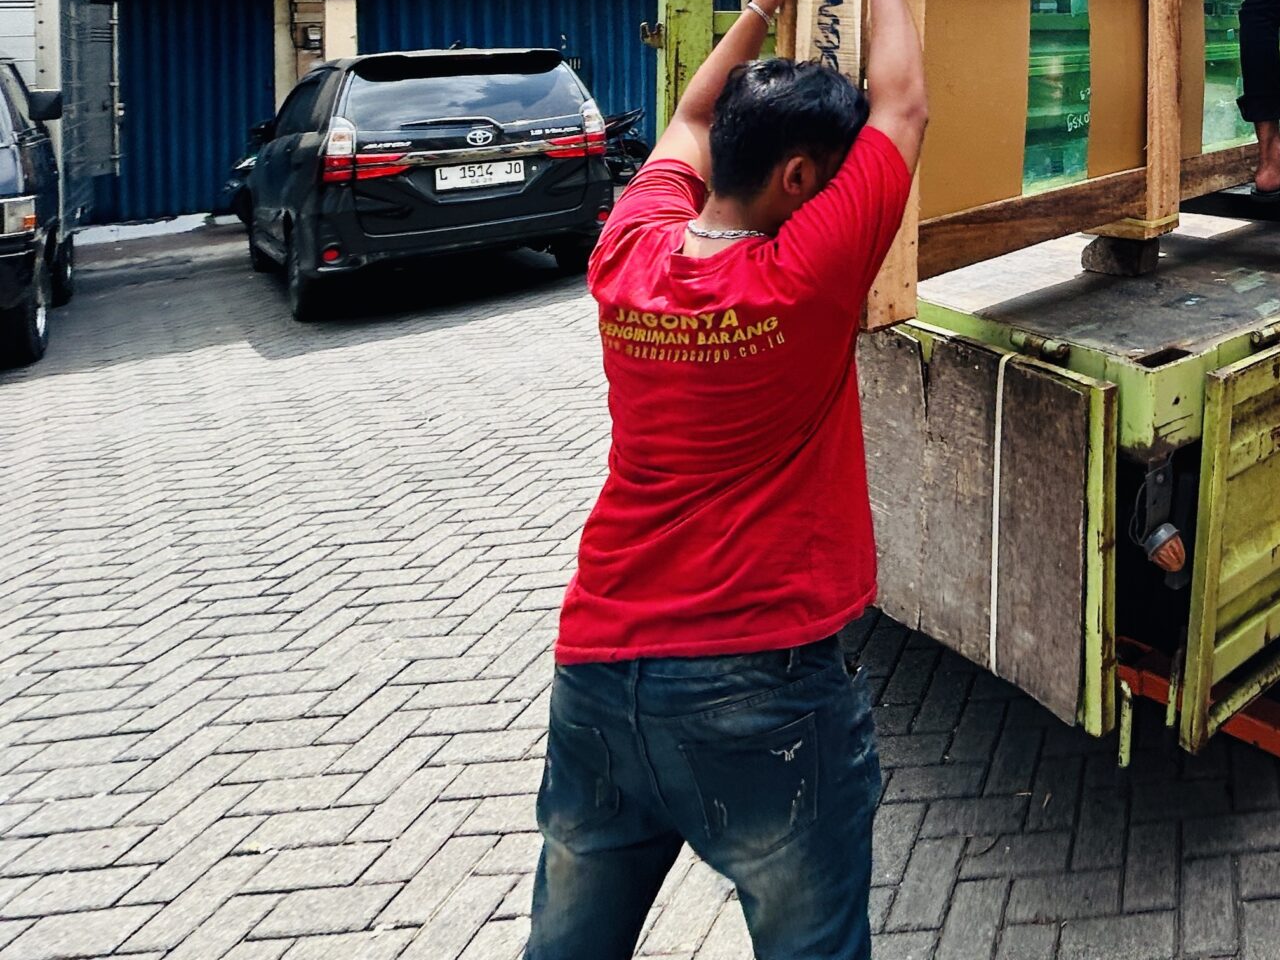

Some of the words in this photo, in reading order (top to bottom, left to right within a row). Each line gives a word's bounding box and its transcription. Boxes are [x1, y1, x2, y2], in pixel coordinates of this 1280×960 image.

[439, 169, 448, 181] L
[459, 164, 493, 179] 1514
[616, 308, 739, 330] JAGONYA
[600, 321, 690, 346] PENGIRIMAN
[696, 316, 779, 346] BARANG
